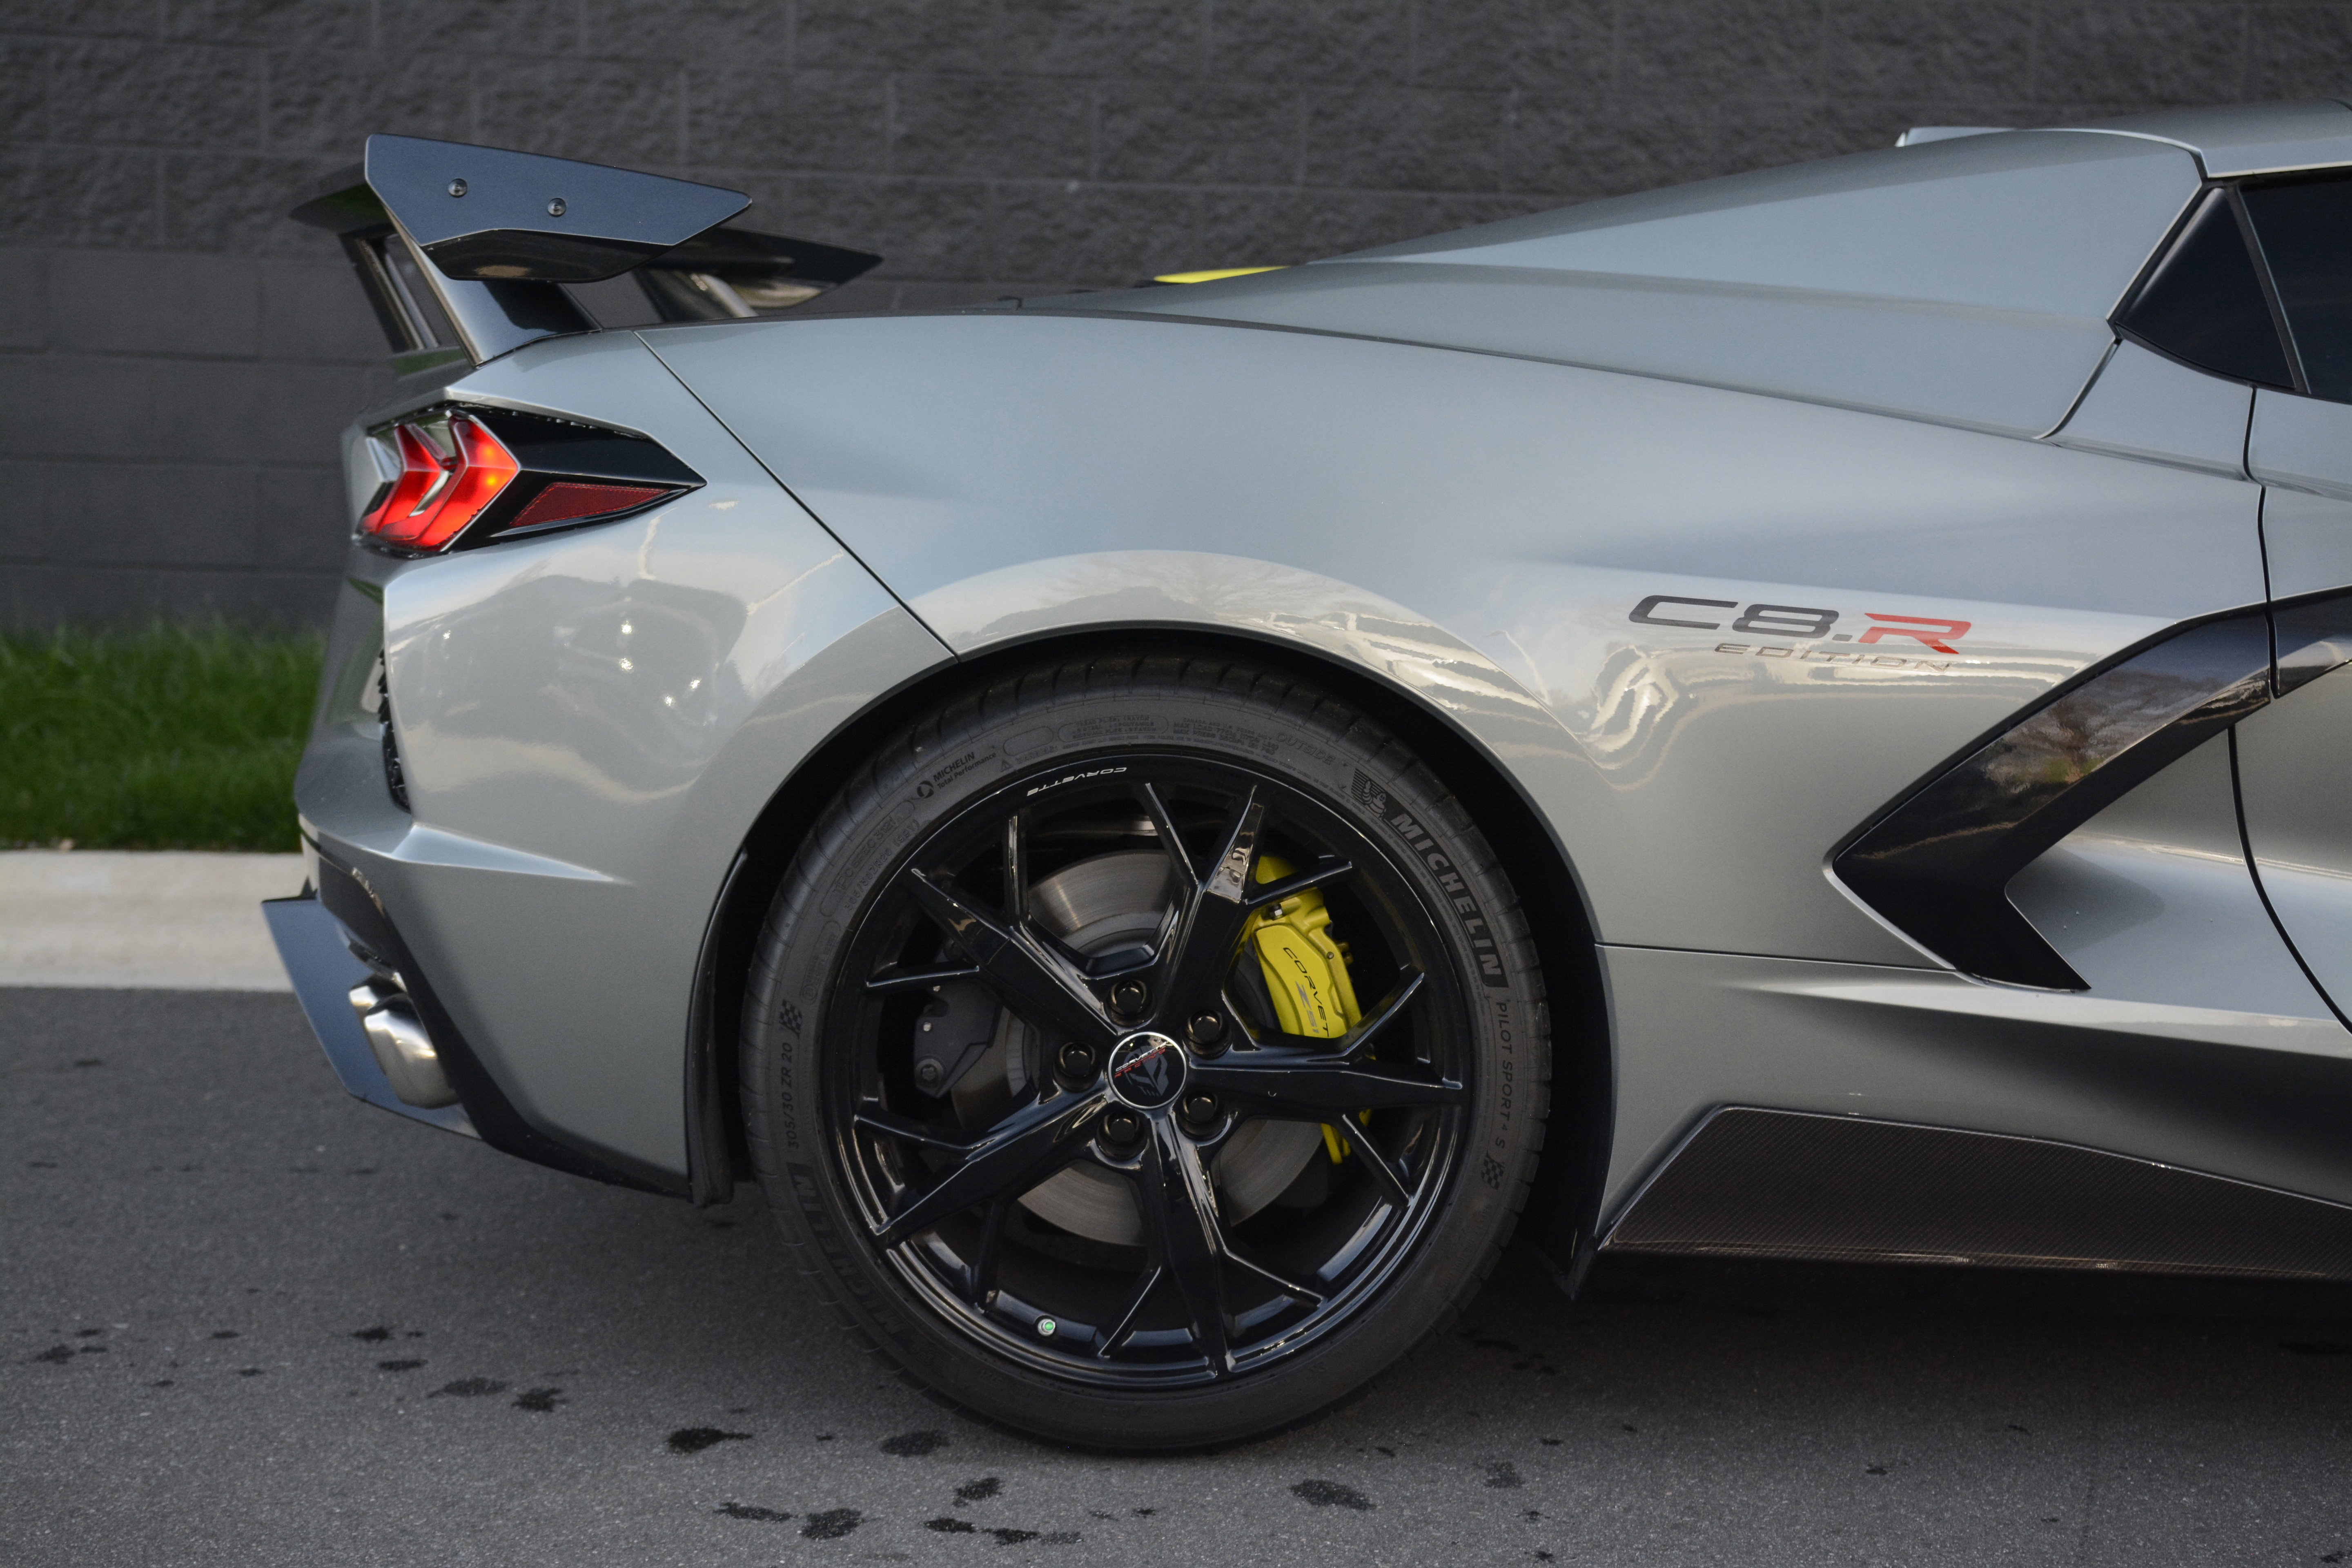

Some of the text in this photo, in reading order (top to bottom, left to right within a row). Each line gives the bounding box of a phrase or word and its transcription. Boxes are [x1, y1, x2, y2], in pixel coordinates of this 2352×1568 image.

[1628, 595, 1972, 654] C8.R
[1715, 643, 1952, 673] EDITION
[933, 752, 975, 781] MICHELIN
[937, 752, 996, 790] Total Performance
[1277, 732, 1335, 766] OUTSIDE
[1027, 767, 1127, 796] CORVETTE
[852, 837, 877, 869] SPEC
[1391, 813, 1502, 976] MICHELIN
[1283, 947, 1329, 1037] CORVET
[1295, 980, 1320, 1033] Z51
[1496, 1001, 1512, 1054] PILOT
[1116, 1041, 1167, 1072] CORVETTE
[781, 1042, 800, 1150] 305/30 ZR 20
[1499, 1060, 1512, 1120] SPORT
[1494, 1136, 1506, 1149] S
[793, 1174, 908, 1336] MICHELIN
